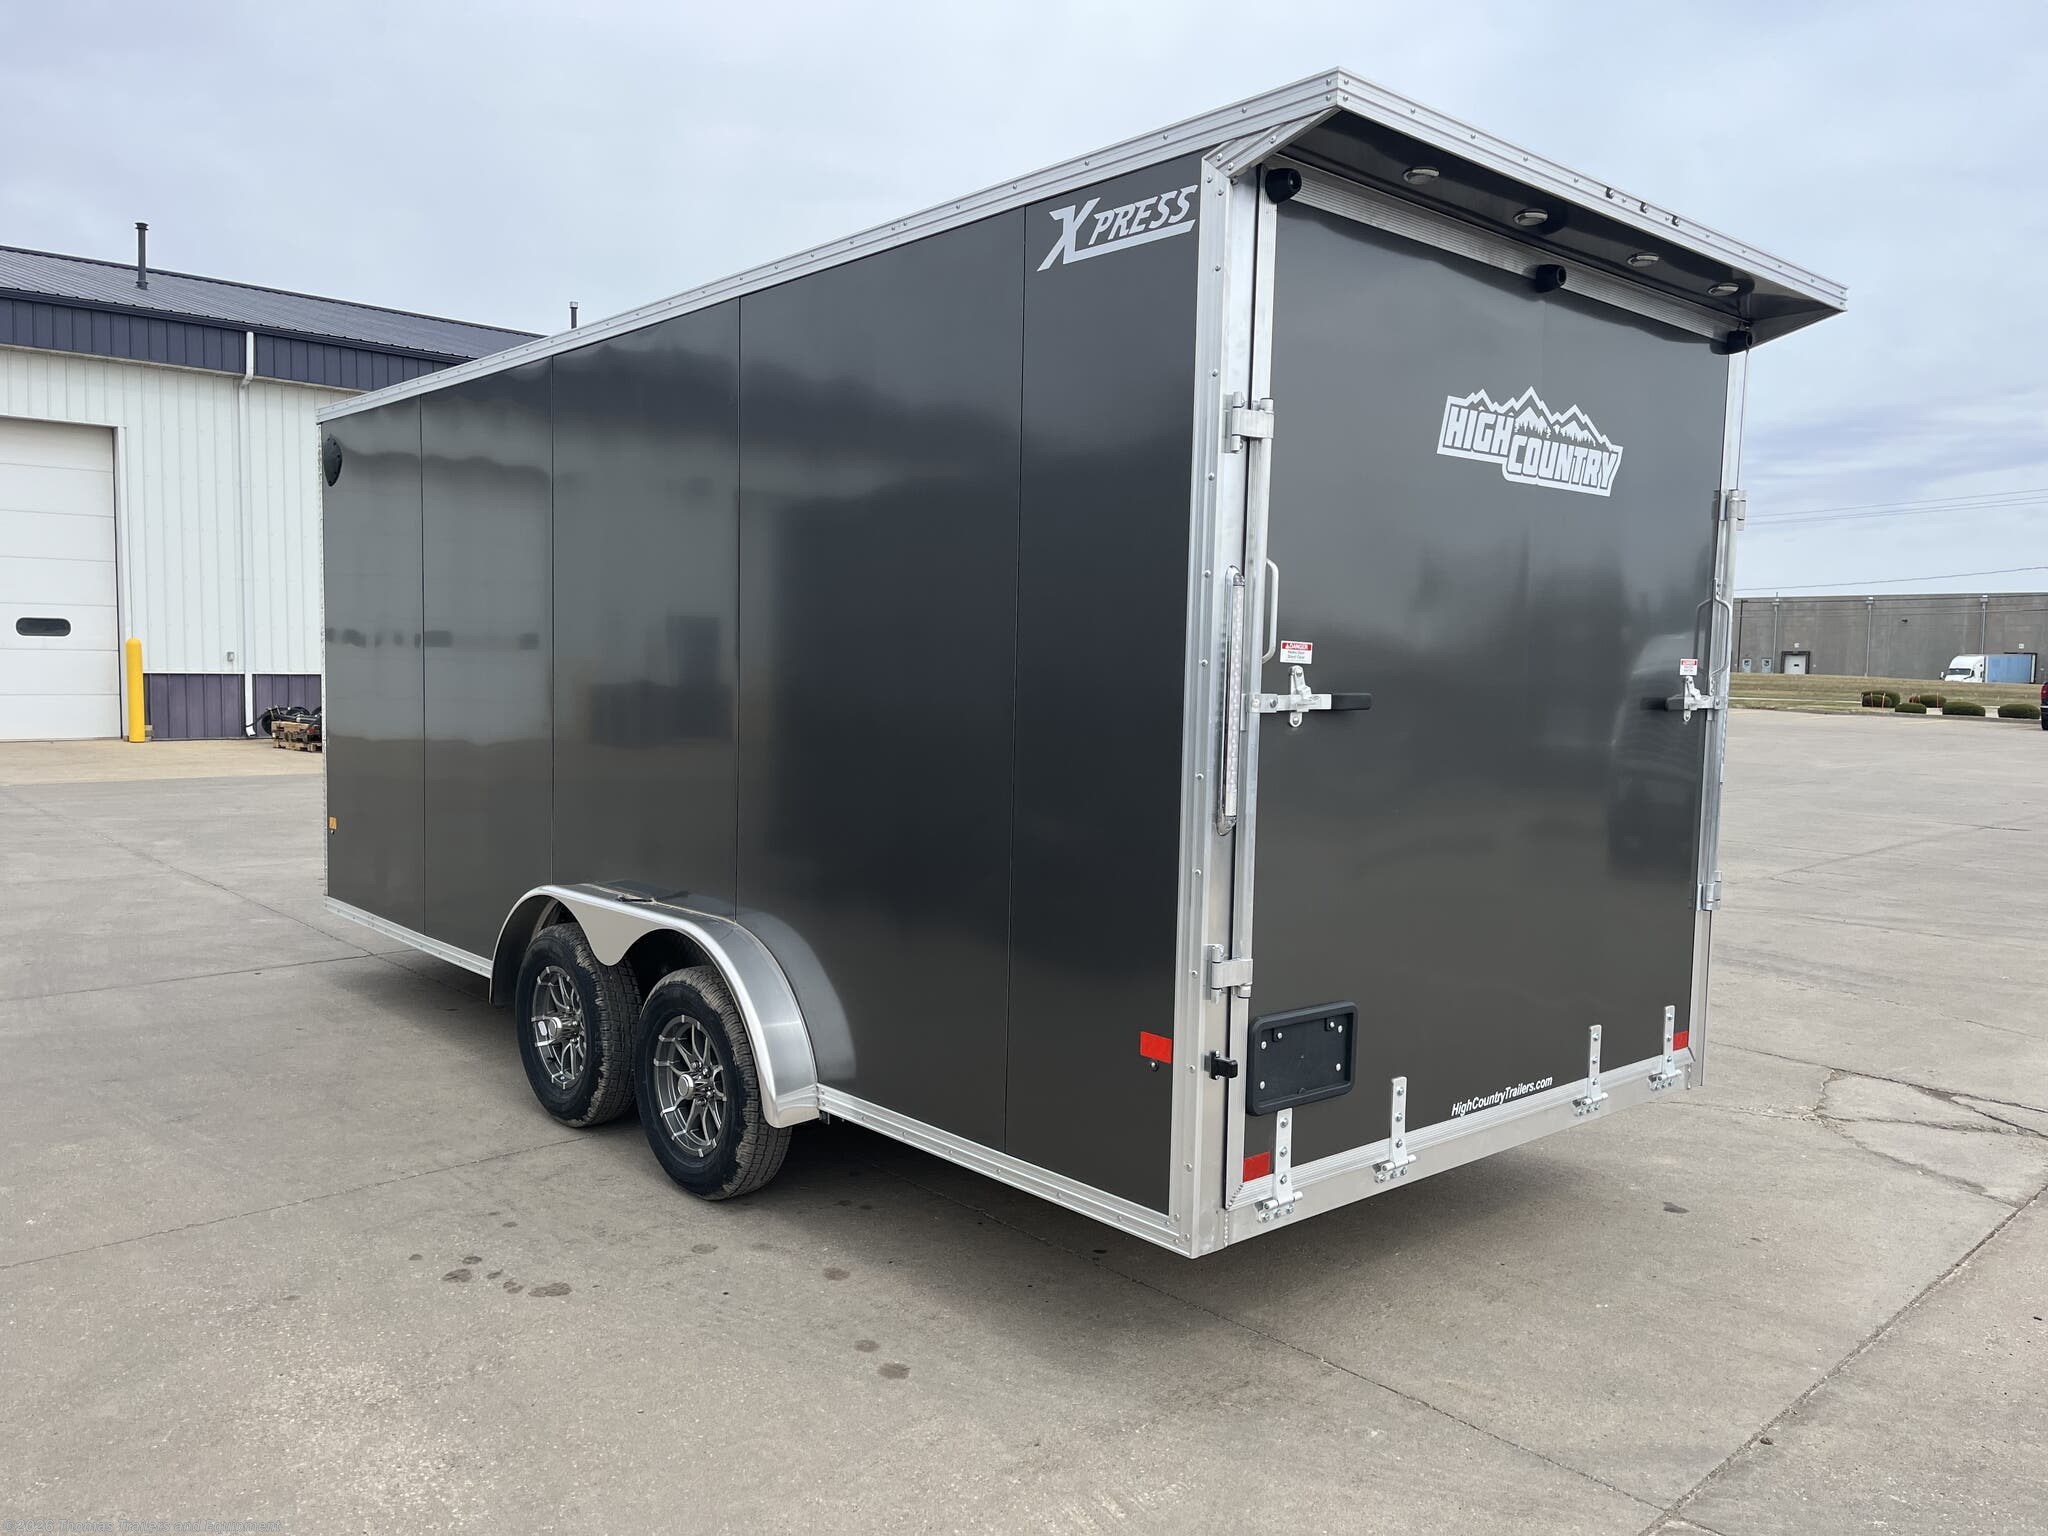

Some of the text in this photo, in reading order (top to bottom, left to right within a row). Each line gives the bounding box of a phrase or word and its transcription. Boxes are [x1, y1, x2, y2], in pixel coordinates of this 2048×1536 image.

[1037, 185, 1198, 271] XPRESS
[1443, 406, 1514, 456] HIGH
[1507, 435, 1617, 488] COUNTRY
[1451, 1077, 1553, 1116] HighCountryTrailers.com
